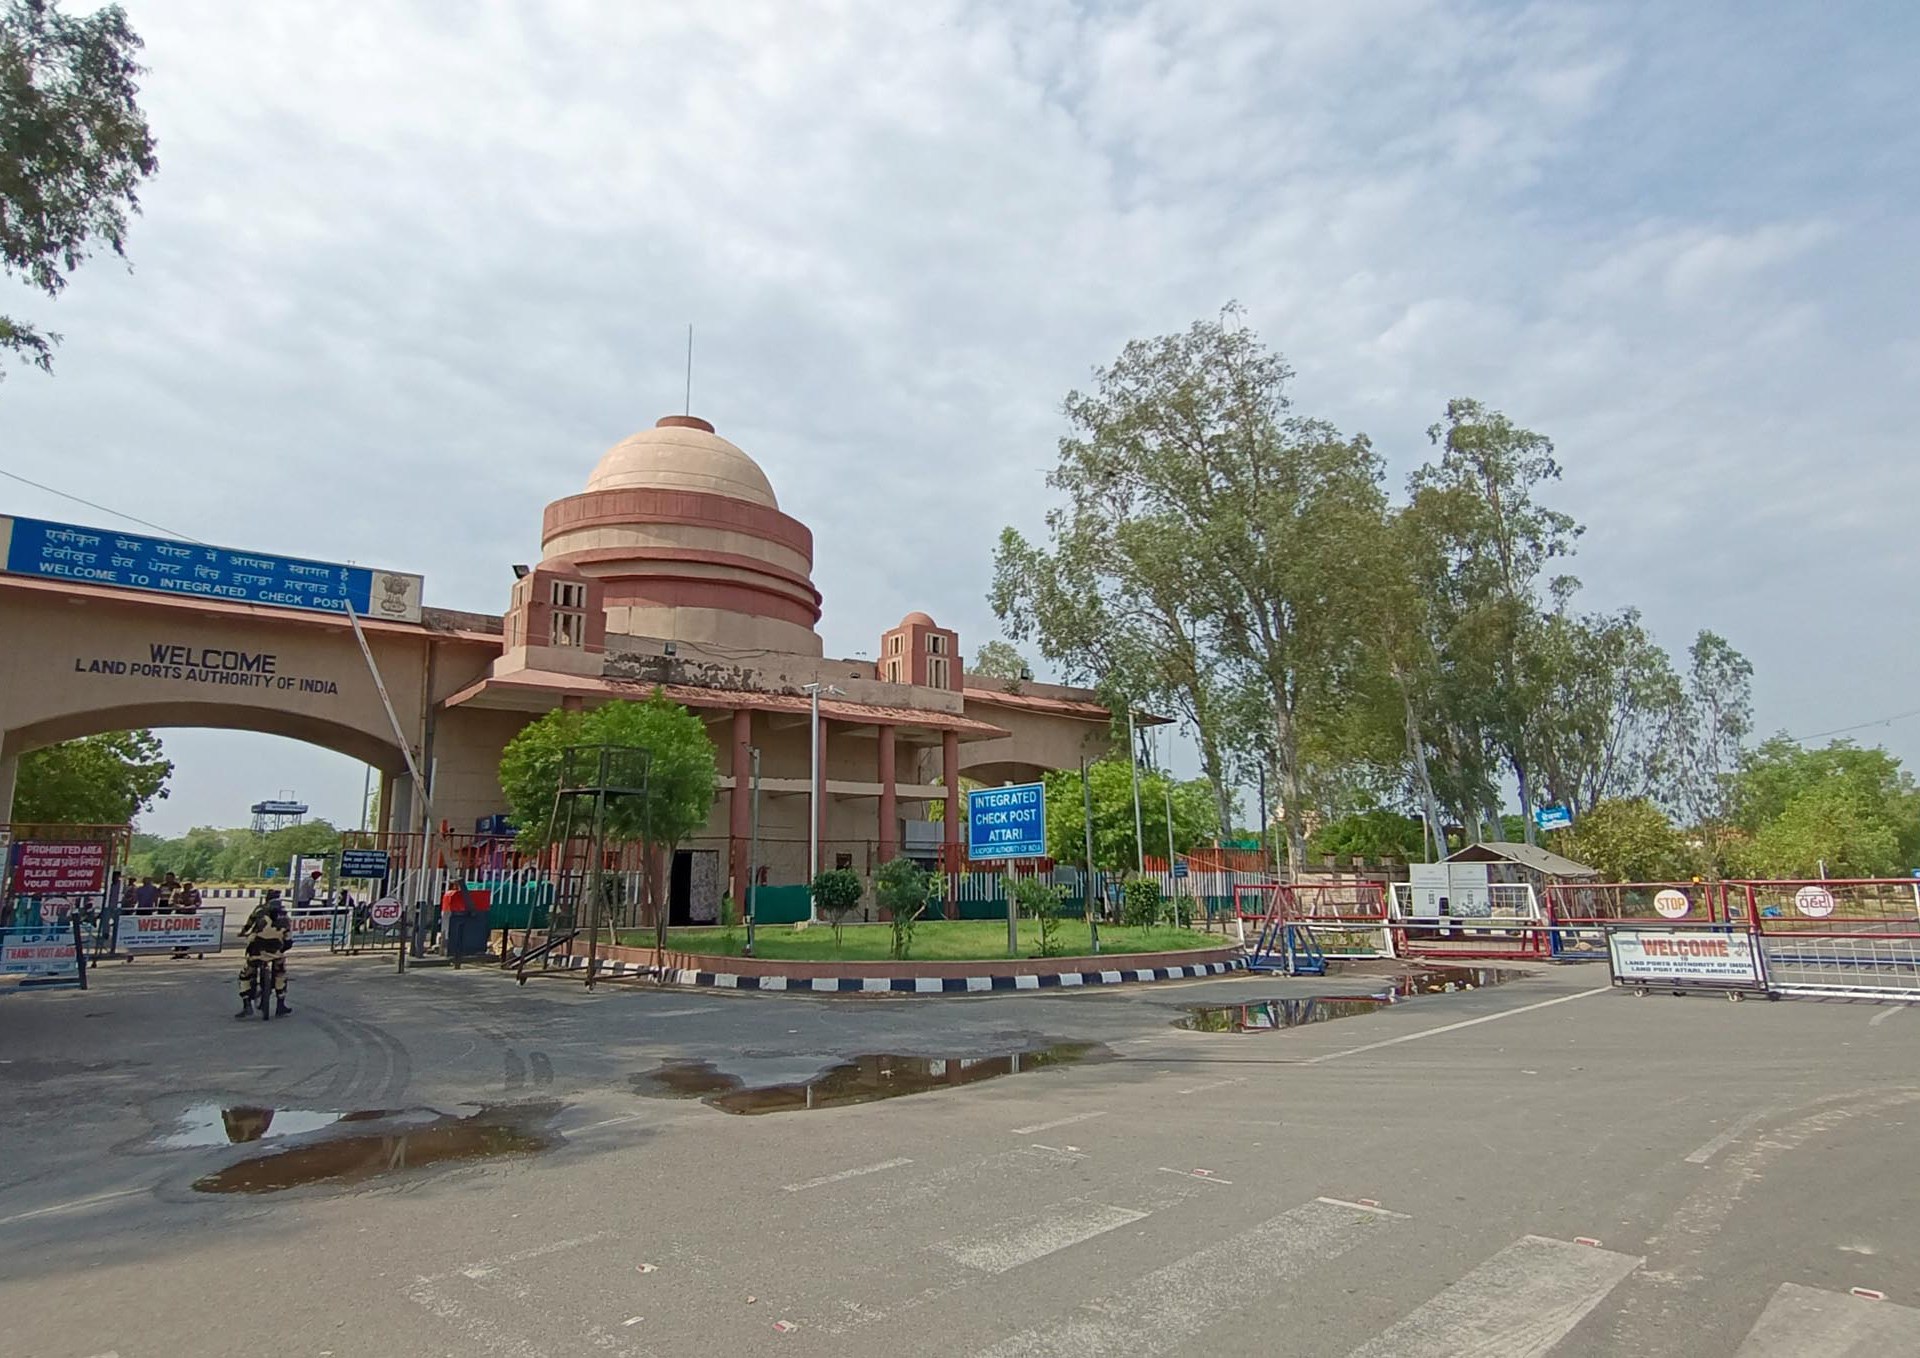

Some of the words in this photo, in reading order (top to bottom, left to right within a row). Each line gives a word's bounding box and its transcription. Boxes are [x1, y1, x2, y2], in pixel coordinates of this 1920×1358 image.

[44, 529, 100, 548] एकीकृत
[115, 536, 142, 552] चेक
[156, 542, 192, 558] पोस्ट
[204, 549, 217, 562] में
[229, 556, 276, 570] आपका
[288, 564, 330, 578] स्वागत
[340, 568, 349, 582] है
[111, 552, 136, 568] ਚੇਕ
[284, 580, 328, 594] ਸਵਾਗਤ
[39, 562, 117, 582] WELCOME
[128, 573, 149, 585] TO
[160, 578, 247, 597] INTEGRATED
[258, 590, 304, 604] CHECK
[313, 596, 344, 609] POST
[149, 644, 276, 674] WELCOME
[74, 658, 127, 675] LAND
[130, 662, 182, 679] PORTS
[185, 668, 274, 688] AUTHORITY
[276, 676, 295, 690] OF
[300, 679, 338, 695] INDIA
[975, 791, 1036, 808] INTEGRATED
[976, 812, 1008, 824] CHECK
[1010, 809, 1036, 822] POST
[988, 828, 1022, 842] ATTARI
[26, 845, 80, 854] PROHIBITED
[82, 846, 102, 854] AREA
[24, 869, 58, 877] PLEASE
[67, 869, 94, 877] SHOW
[24, 880, 50, 888] YOUR
[55, 880, 93, 888] IDENTITY
[1657, 897, 1686, 910] STOP
[138, 917, 202, 932] WELCOME
[292, 918, 331, 931] LCOME
[1640, 939, 1729, 957] WELCOME
